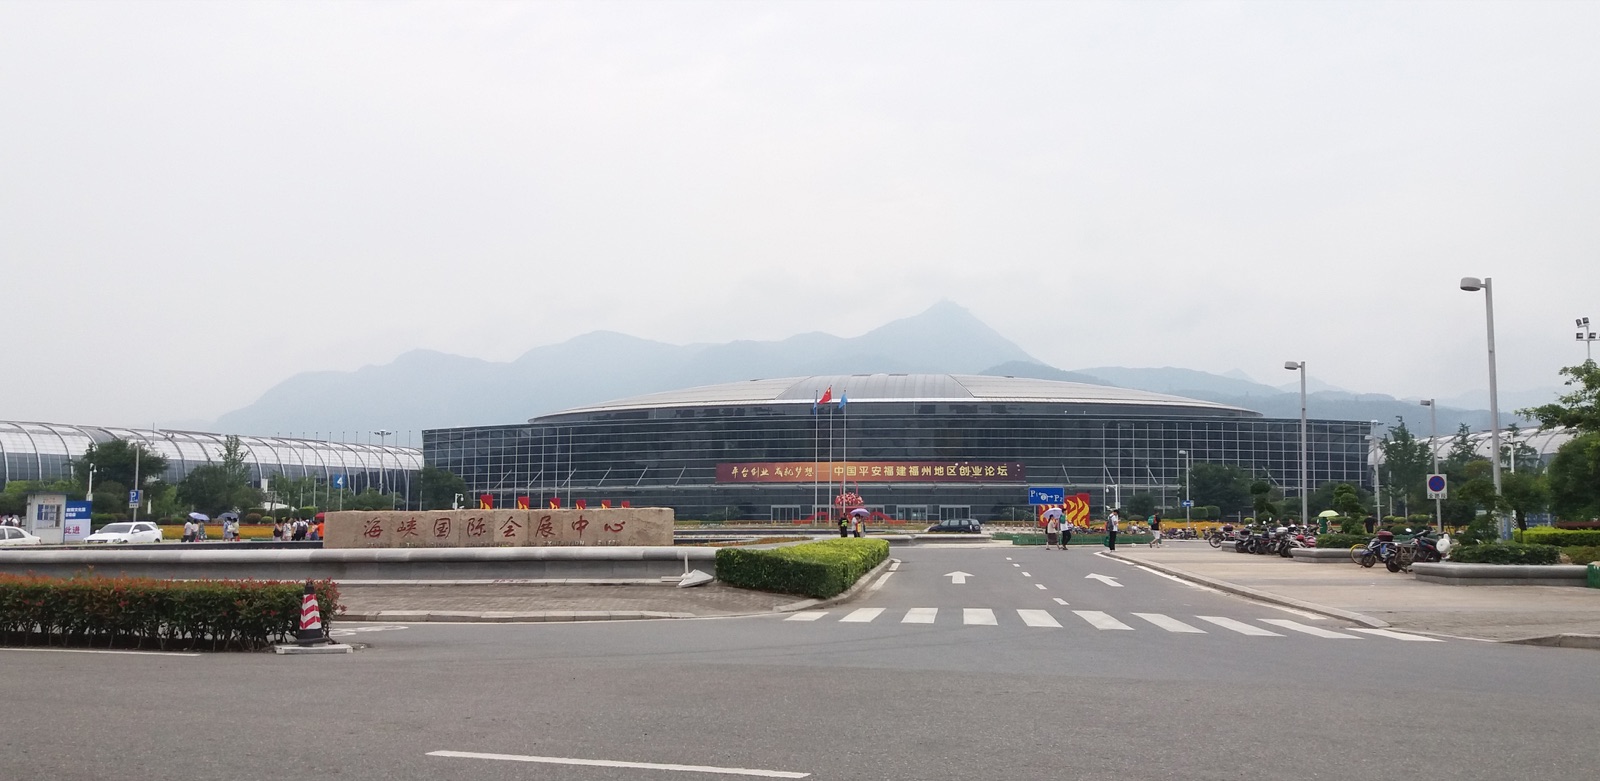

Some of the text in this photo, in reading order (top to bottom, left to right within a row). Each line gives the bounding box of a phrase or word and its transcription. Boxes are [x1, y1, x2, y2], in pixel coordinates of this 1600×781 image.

[833, 465, 1008, 477] 中国平安福建福州地区创业论坛
[337, 477, 343, 486] 4
[363, 514, 626, 538] 海峡国际会展中心
